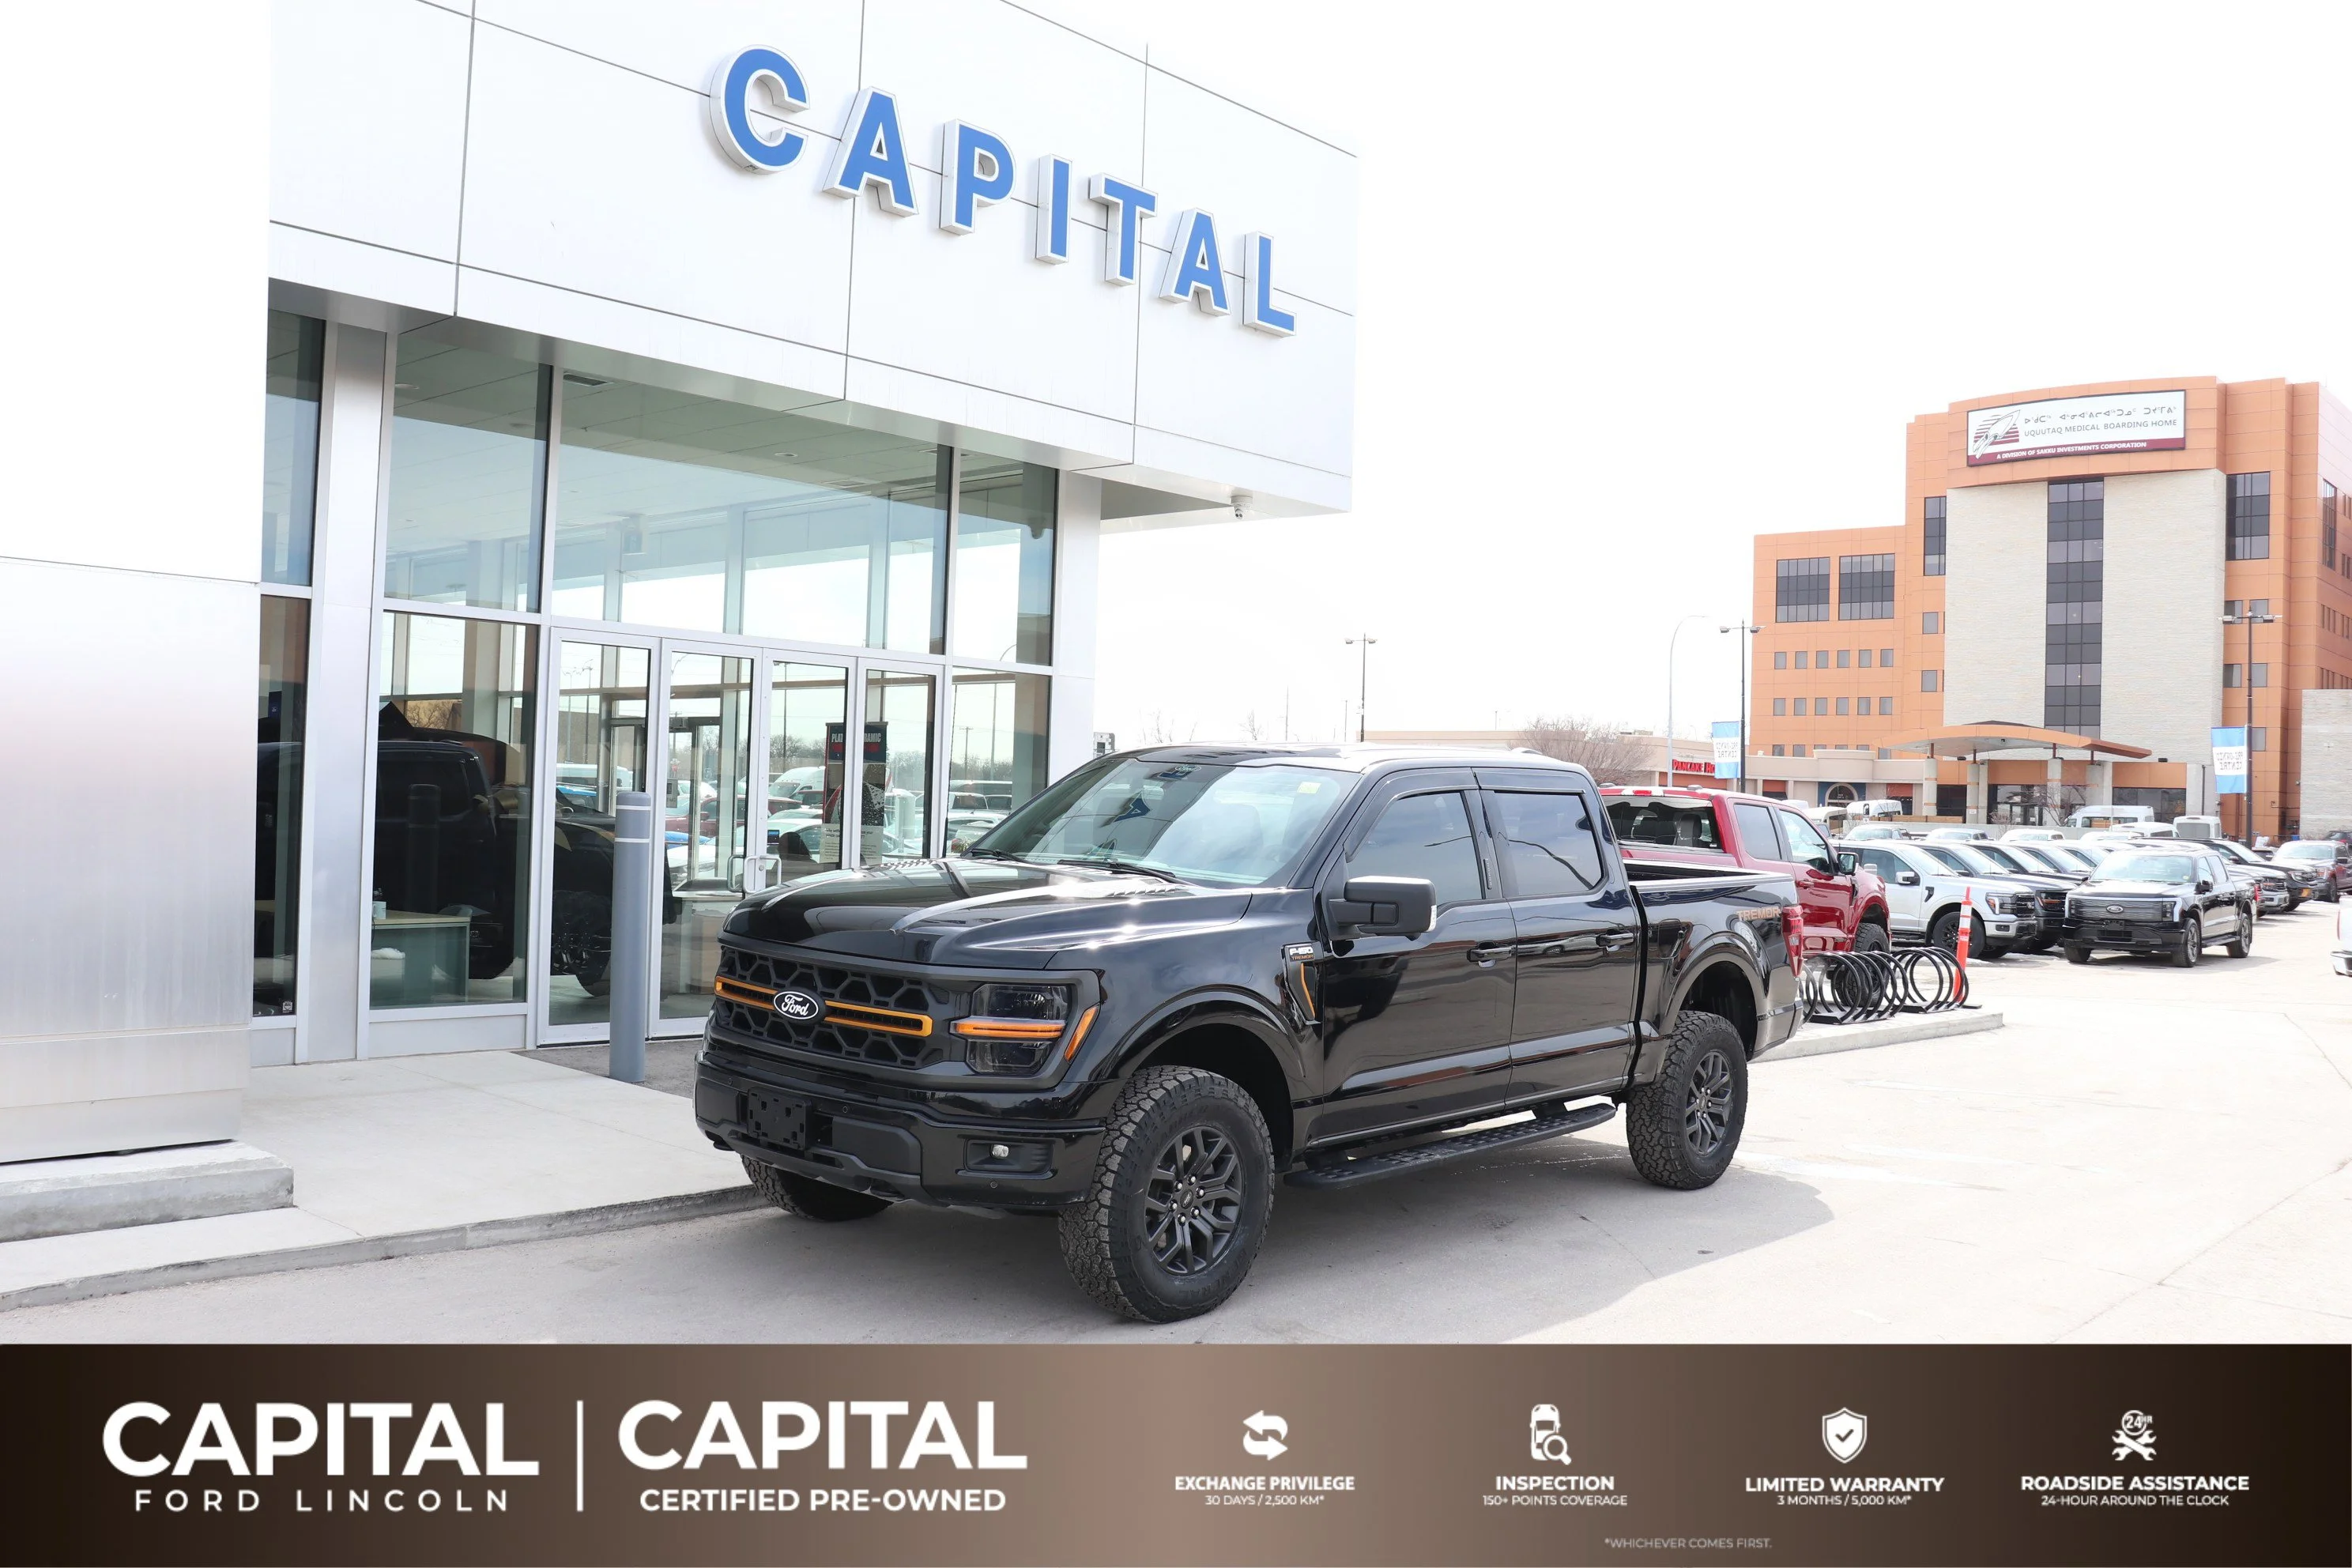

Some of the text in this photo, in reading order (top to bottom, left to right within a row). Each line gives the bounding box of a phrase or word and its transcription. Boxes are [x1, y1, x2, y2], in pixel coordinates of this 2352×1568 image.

[710, 44, 1296, 337] CAPITAL
[2024, 427, 2063, 437] UQUUTAQ
[2056, 444, 2099, 453] INVESTMENTS
[831, 733, 881, 743] PLAT RAMIC
[1736, 906, 1781, 922] TREMOR
[781, 994, 809, 1016] Ford
